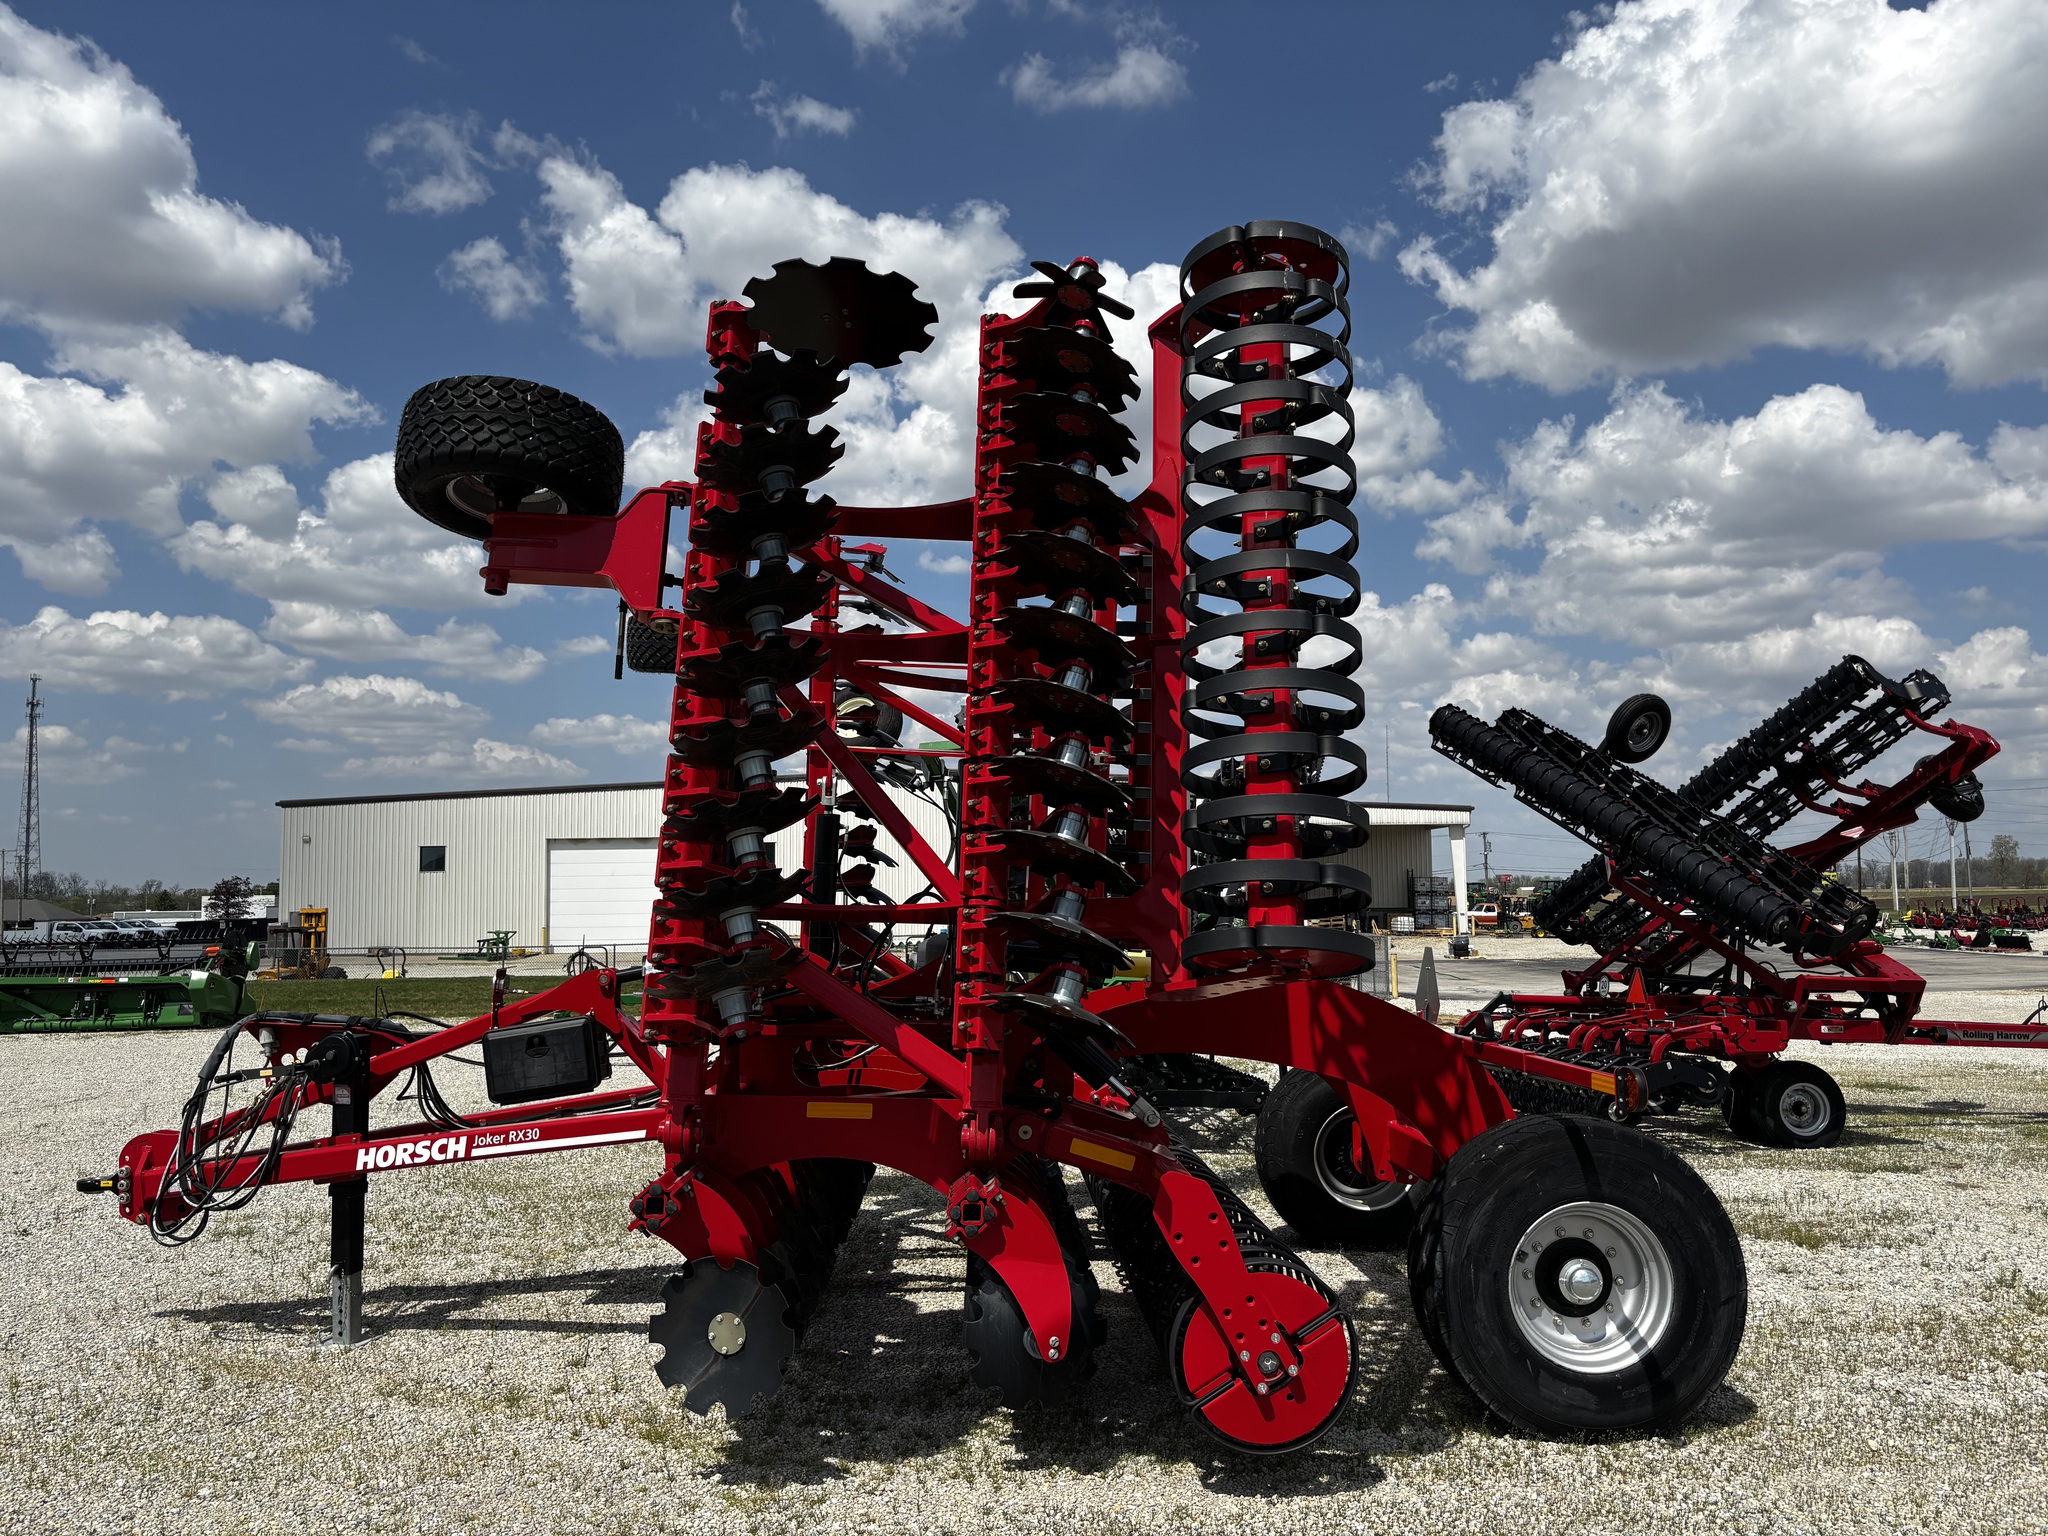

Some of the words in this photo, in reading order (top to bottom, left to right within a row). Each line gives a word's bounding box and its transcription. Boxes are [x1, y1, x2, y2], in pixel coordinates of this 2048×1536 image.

[1962, 1030, 1994, 1040] Rolling
[1996, 1031, 2030, 1040] Harrow
[473, 1132, 506, 1147] Joker
[508, 1128, 540, 1142] RX30
[355, 1136, 467, 1171] HORSCH
